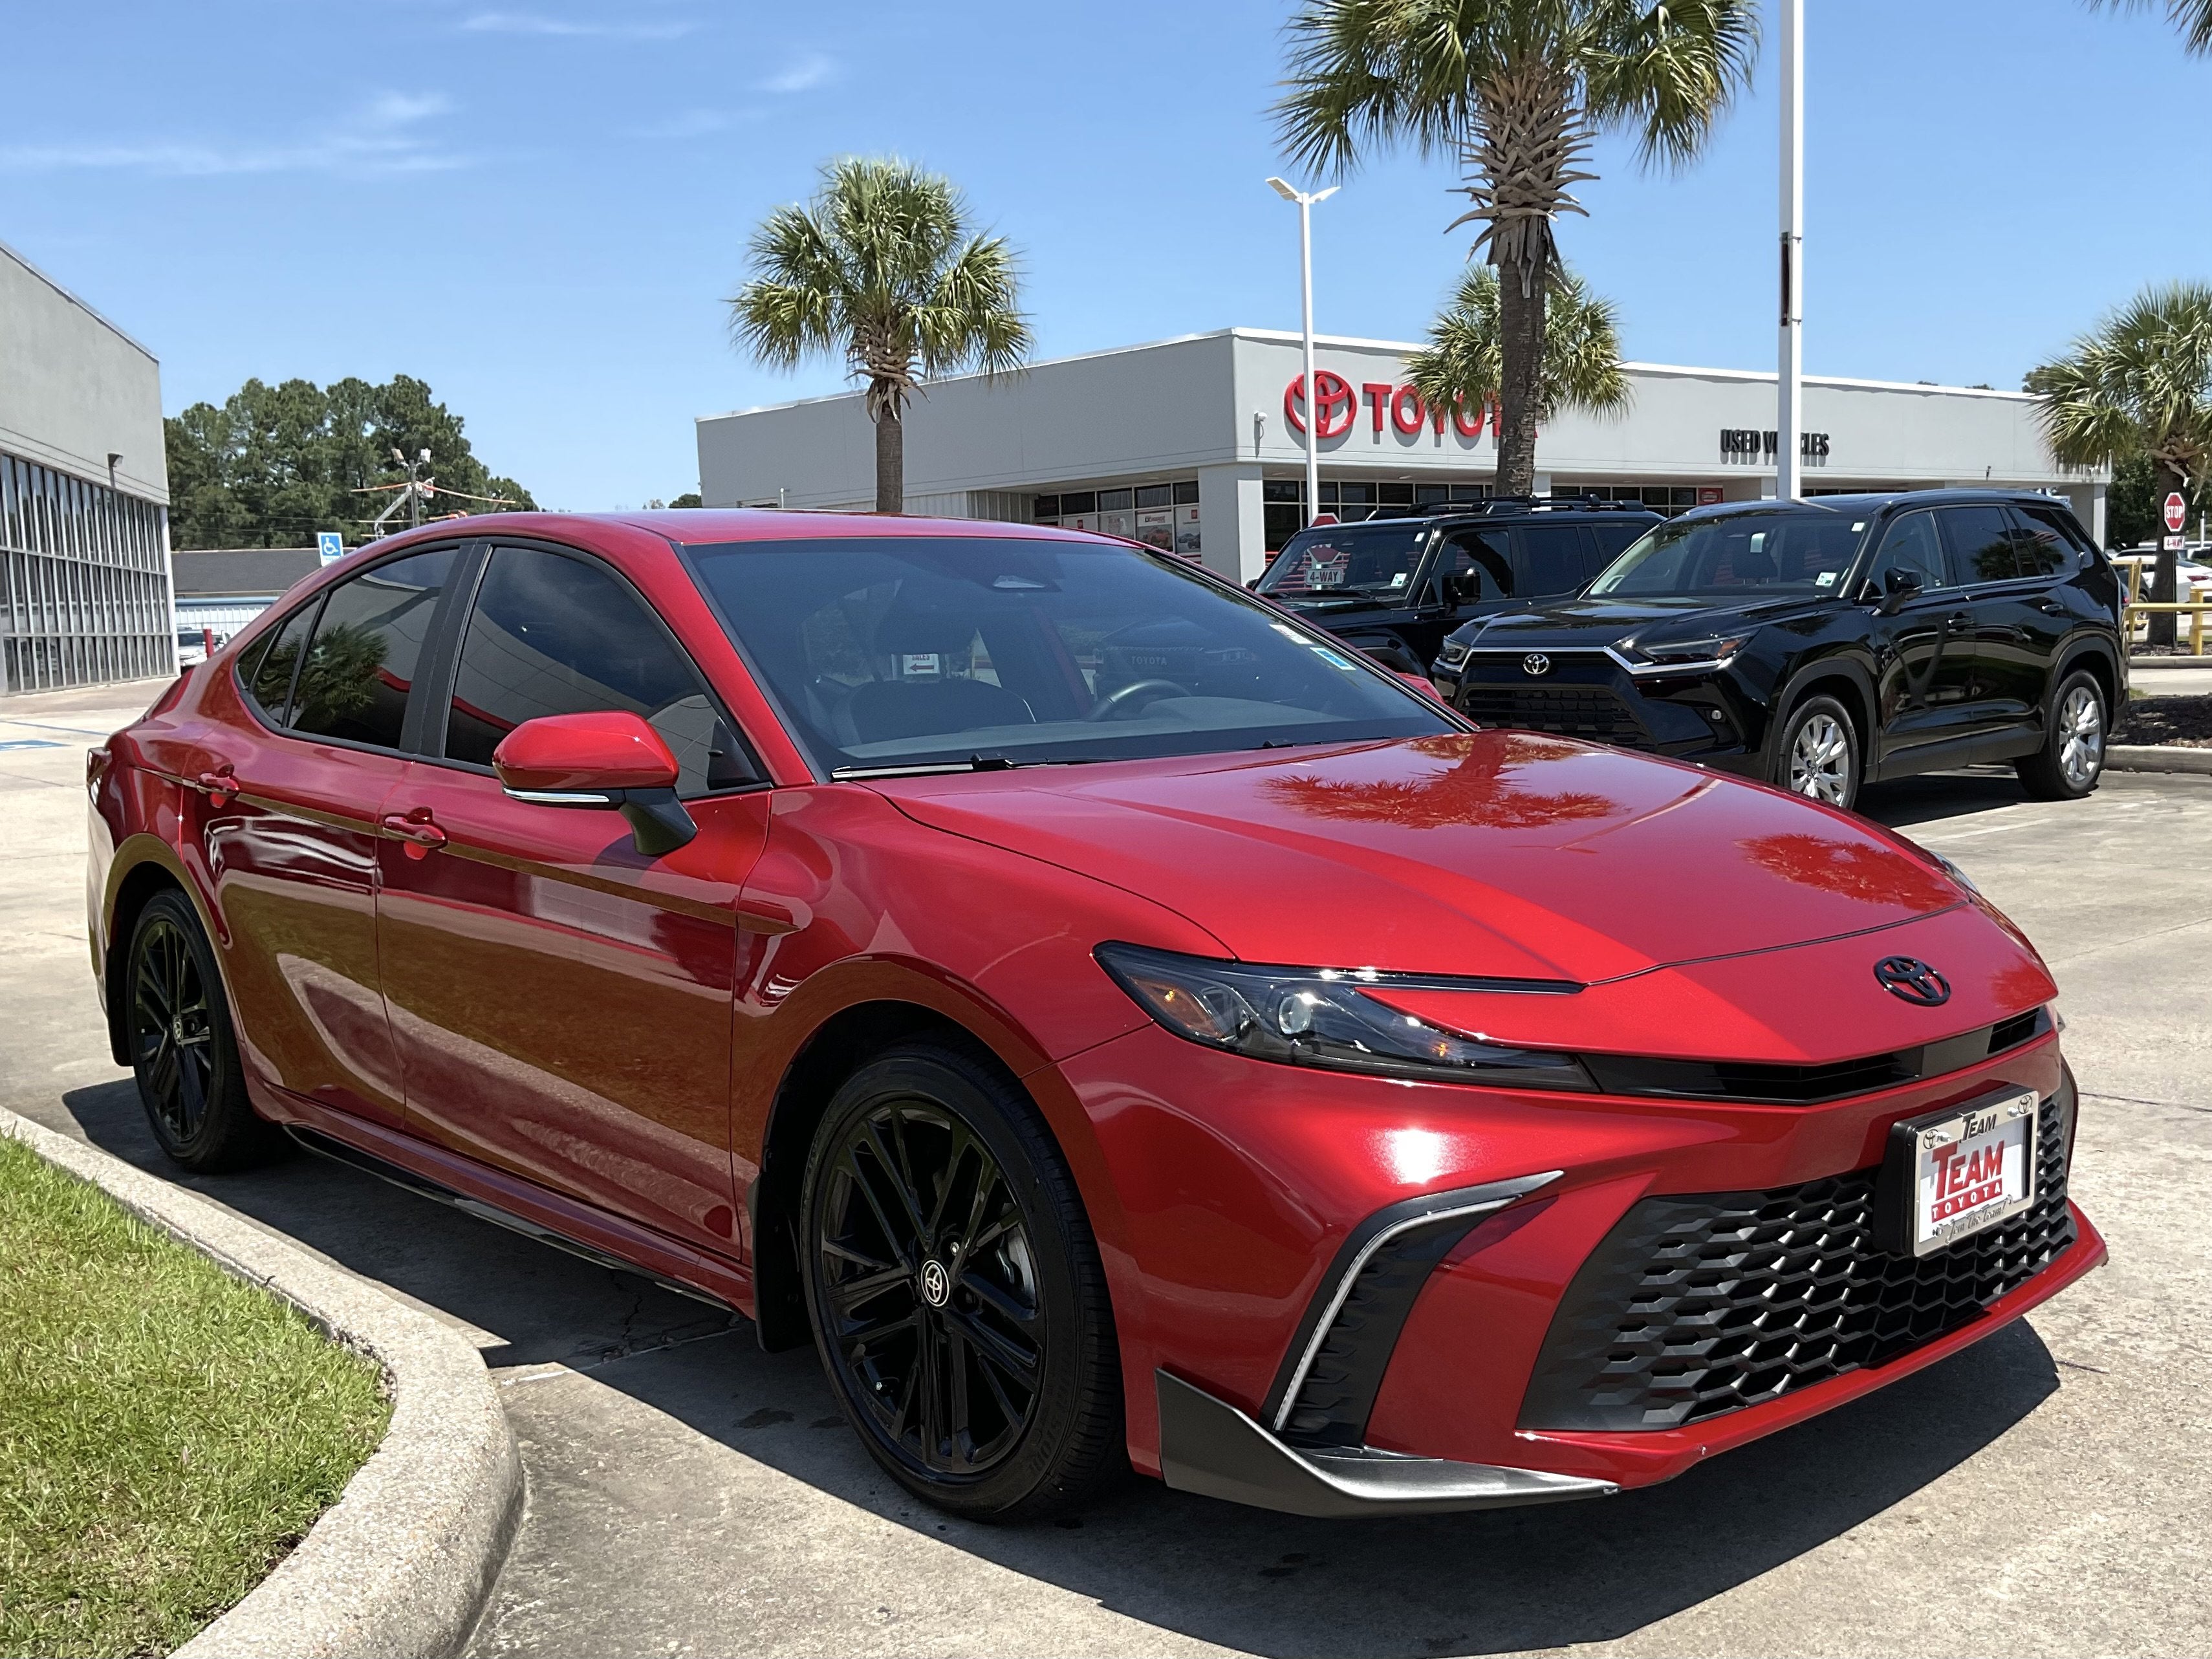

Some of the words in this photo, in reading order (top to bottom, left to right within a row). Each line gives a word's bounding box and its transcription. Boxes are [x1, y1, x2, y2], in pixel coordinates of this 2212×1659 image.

[1362, 382, 1539, 439] TOYOT
[1720, 429, 1761, 453] USED
[2166, 505, 2183, 519] STOP
[2167, 538, 2184, 547] 4-WAY
[1310, 571, 1338, 583] 4-WAY
[1962, 1112, 1997, 1141] TEAM
[1931, 1140, 2004, 1201] TEAM
[1932, 1182, 2001, 1219] TOYOTA
